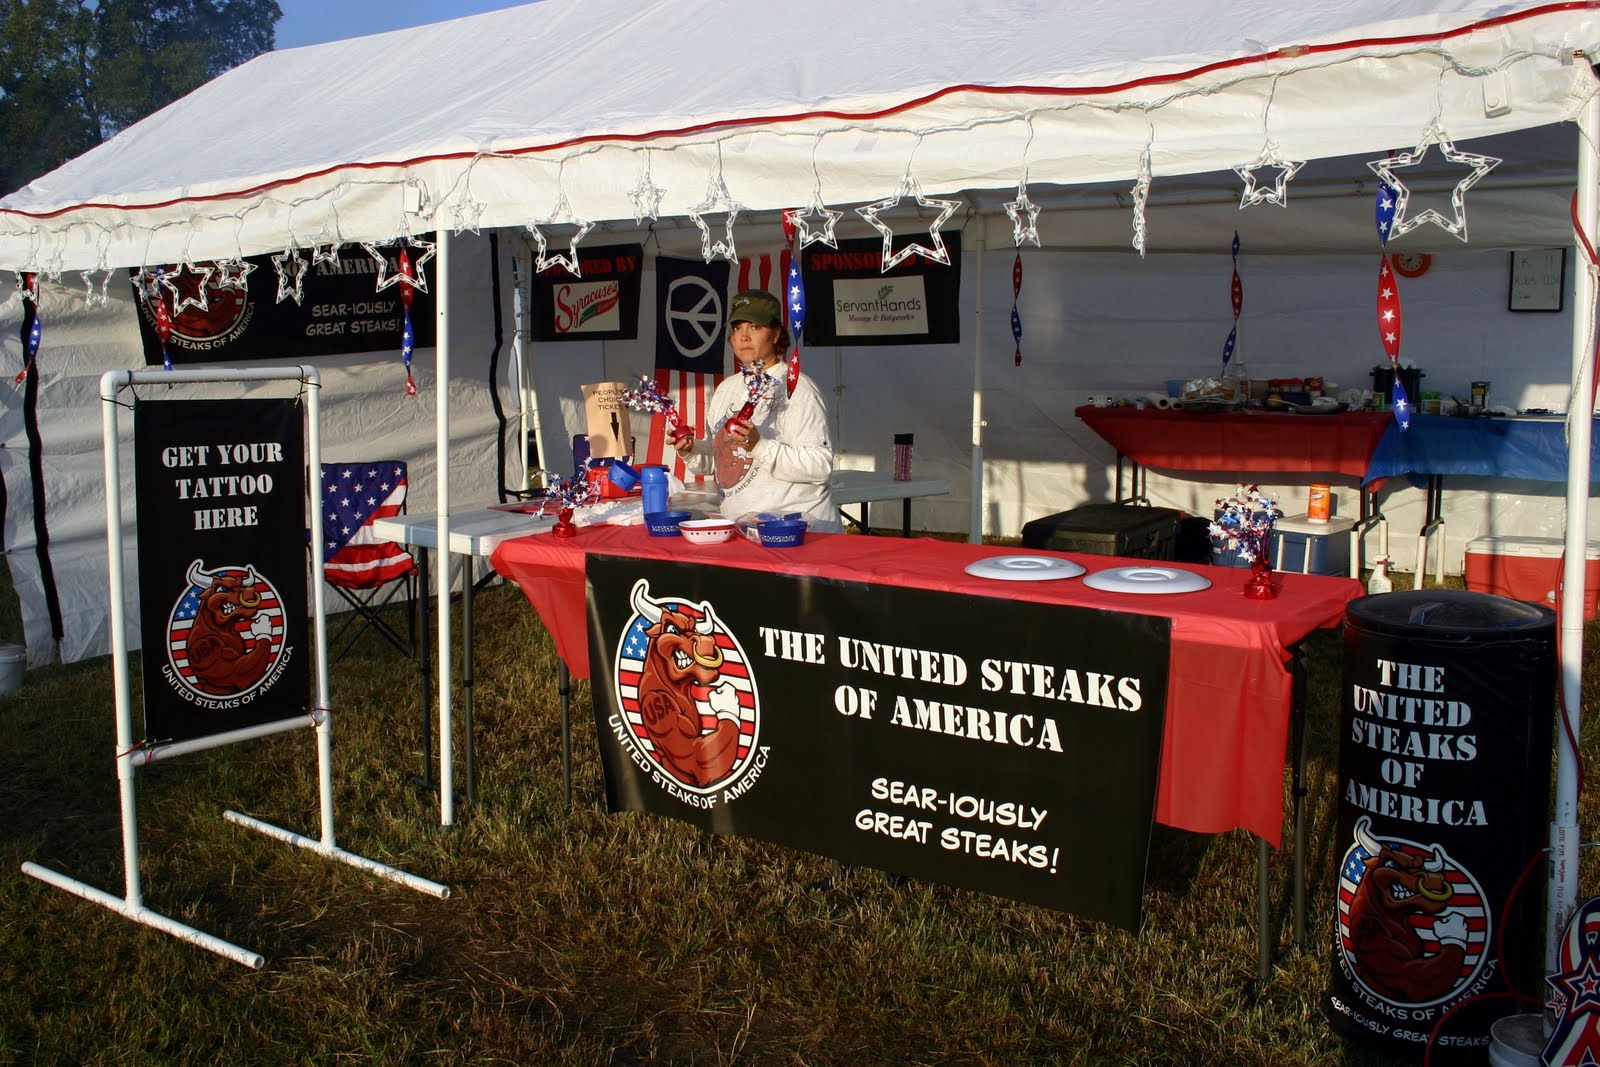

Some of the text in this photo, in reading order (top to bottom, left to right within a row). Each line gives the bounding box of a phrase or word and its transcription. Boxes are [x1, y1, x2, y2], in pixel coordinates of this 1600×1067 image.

[170, 335, 212, 351] STEAKS
[213, 338, 227, 349] OF
[229, 301, 256, 343] AMERICA
[305, 318, 400, 337] GREAT STEAKS!
[312, 301, 396, 317] SEAR-IOUSLY
[555, 281, 619, 333] Syracuse's
[836, 297, 921, 313] ServantHands
[162, 442, 284, 468] GET YOUR
[175, 474, 273, 499] TATTOO
[734, 466, 760, 496] AMERICA
[193, 506, 258, 530] HERE
[162, 646, 294, 710] UNITED STEAKS OF AMERICA
[759, 626, 1143, 713] THE UNITED STEAKS
[1376, 658, 1445, 693] THE
[644, 693, 677, 725] USA
[834, 685, 1064, 753] OF AMERICA
[1353, 684, 1472, 728] UNITED
[608, 714, 771, 810] UNITED STEAKS OF AMERICA
[1351, 716, 1478, 762] STEAKS
[1380, 757, 1425, 788] OF
[871, 777, 1048, 831] SEAR-IOUSLY
[1345, 778, 1488, 826] AMERICA
[855, 809, 1060, 875] GREAT STEAKS!
[1334, 920, 1352, 981] UNITED
[1352, 981, 1408, 1021] STEAKS
[1412, 1009, 1436, 1021] OF
[1331, 996, 1390, 1035] SEAR-IOUSLY
[1393, 1029, 1430, 1044] GREA
